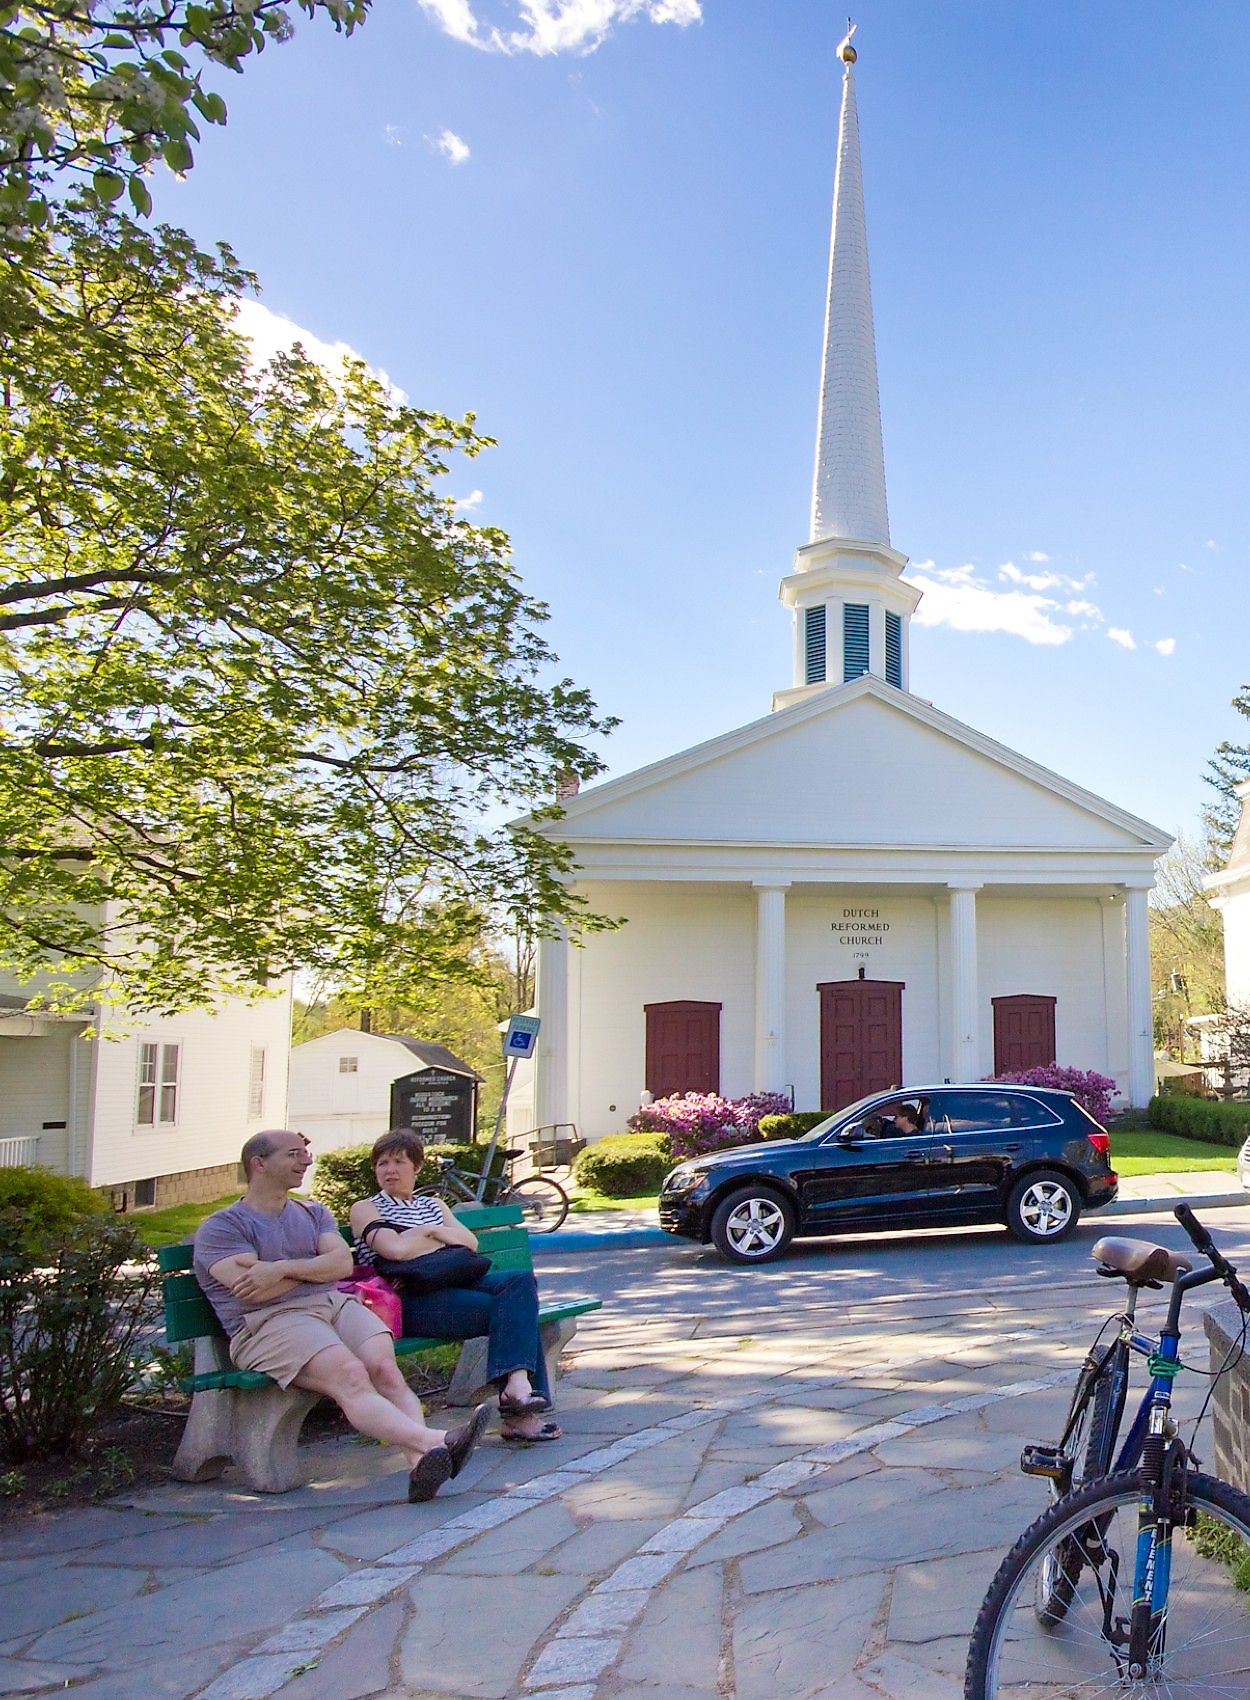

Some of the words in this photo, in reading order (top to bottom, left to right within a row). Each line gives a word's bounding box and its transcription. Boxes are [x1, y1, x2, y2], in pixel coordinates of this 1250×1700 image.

[843, 908, 879, 918] DUTCH
[831, 922, 890, 931] REFORMED
[839, 936, 883, 945] CHURCH
[1144, 1528, 1158, 1602] ELEMENT
